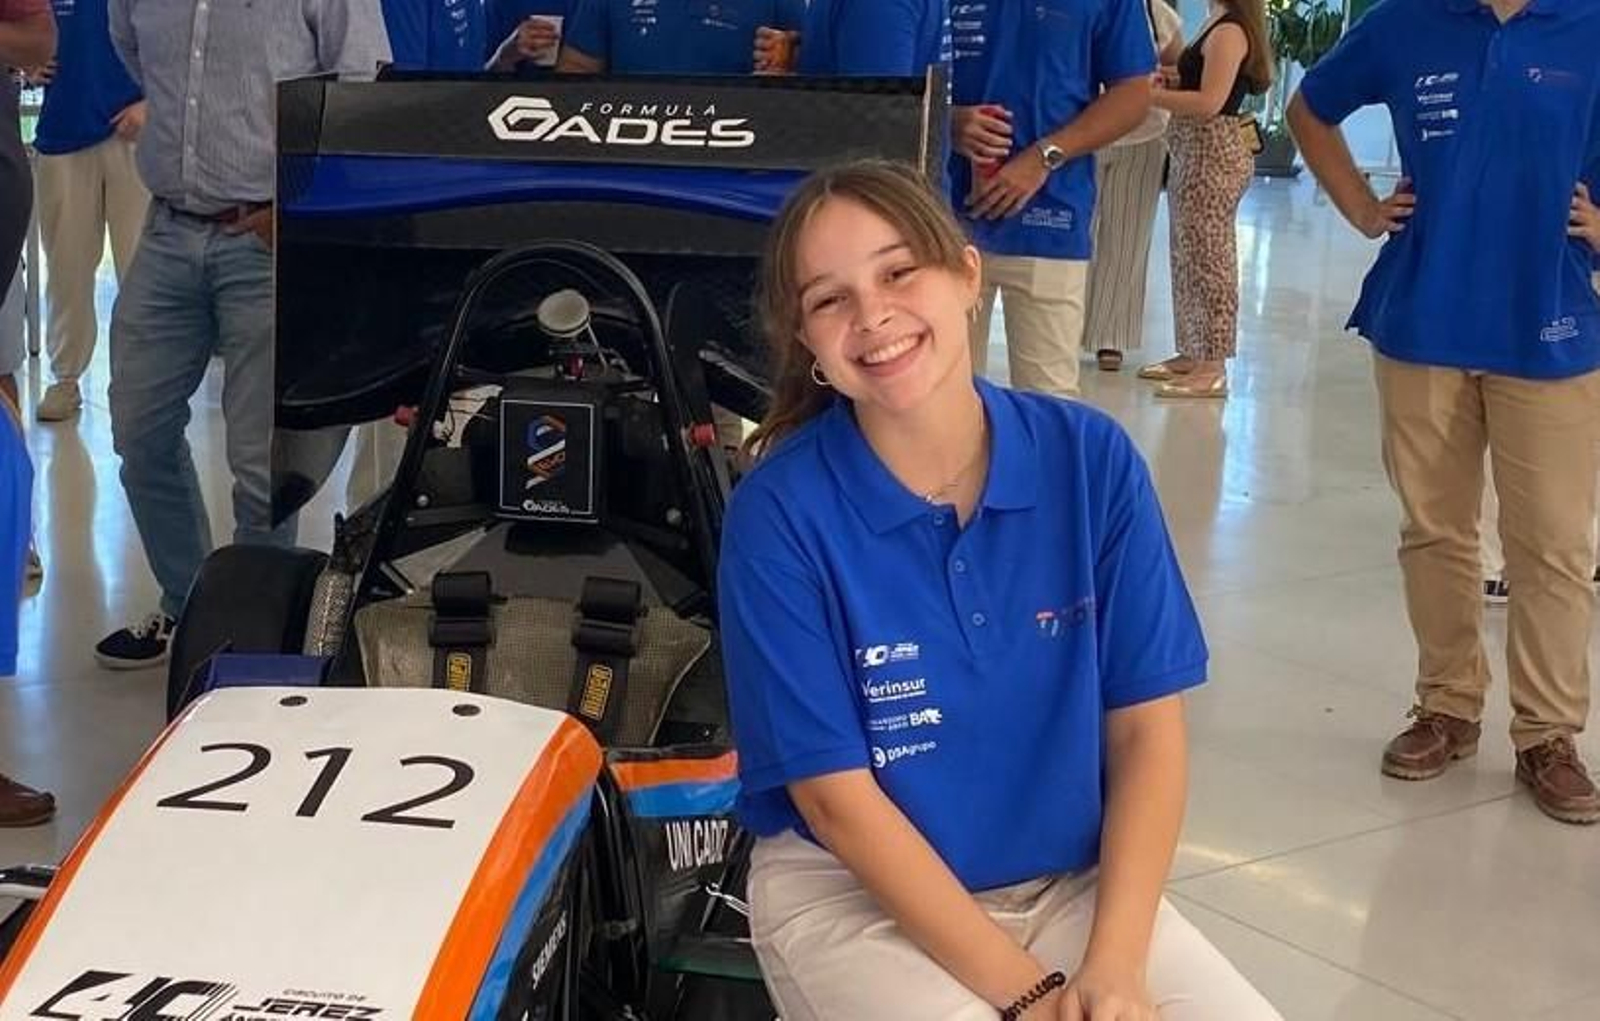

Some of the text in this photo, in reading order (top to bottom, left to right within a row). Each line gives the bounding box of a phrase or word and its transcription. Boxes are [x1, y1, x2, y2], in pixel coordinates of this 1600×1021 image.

[488, 95, 755, 148] GADES
[580, 102, 717, 116] FORMULA
[861, 678, 926, 698] Verinsur
[156, 742, 476, 829] 212
[665, 821, 693, 872] UNI
[232, 998, 384, 1021] JEREZ
